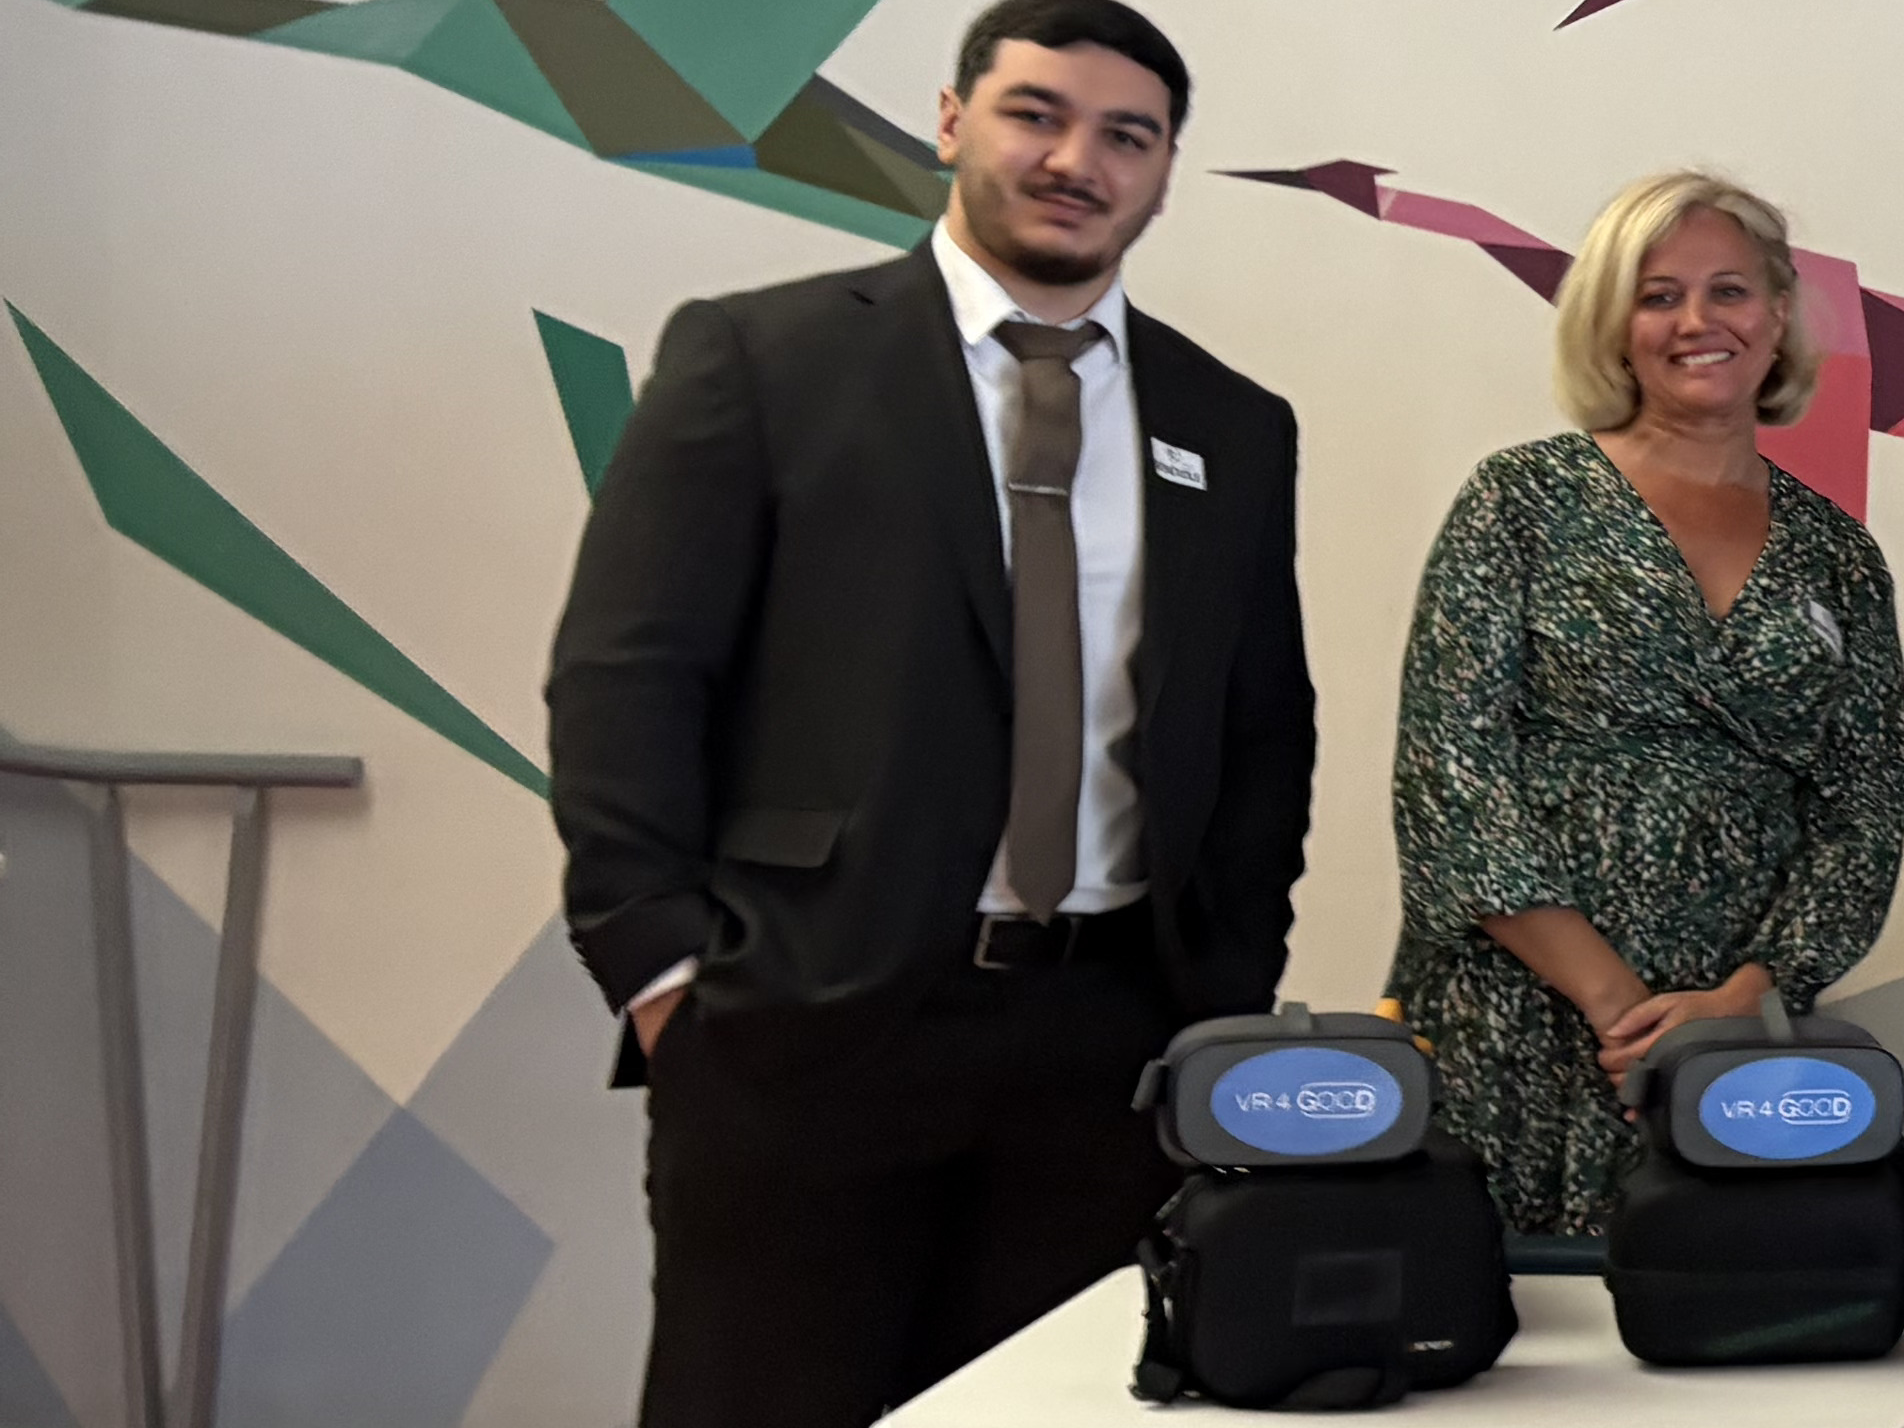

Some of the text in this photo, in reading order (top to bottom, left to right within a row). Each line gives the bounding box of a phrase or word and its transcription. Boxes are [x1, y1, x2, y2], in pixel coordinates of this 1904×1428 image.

[1235, 1089, 1377, 1114] VR 4 GOOD
[1721, 1096, 1851, 1119] VR 4 GOOD
